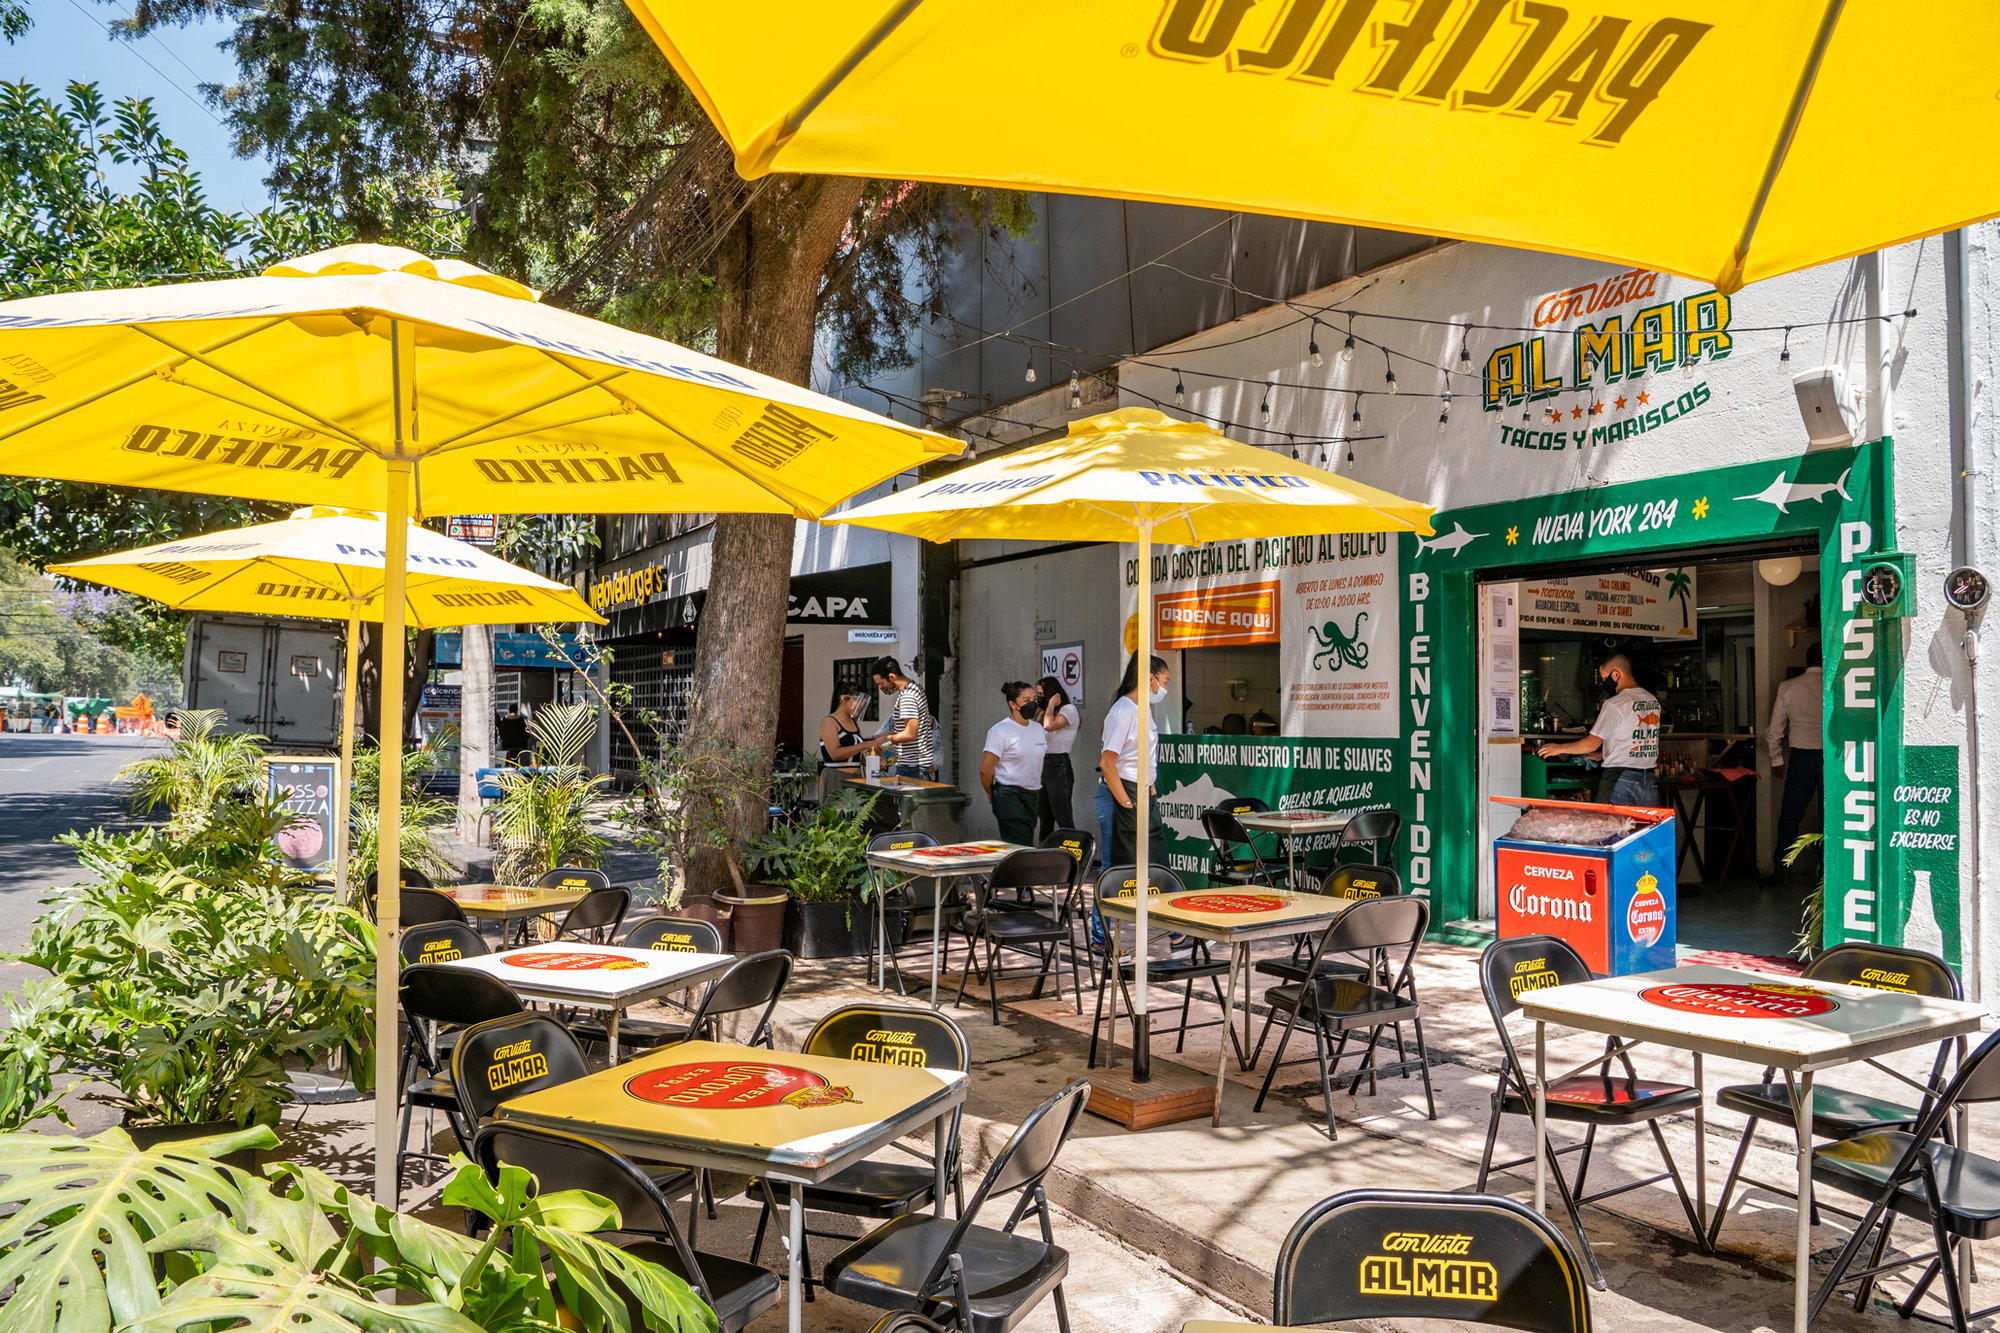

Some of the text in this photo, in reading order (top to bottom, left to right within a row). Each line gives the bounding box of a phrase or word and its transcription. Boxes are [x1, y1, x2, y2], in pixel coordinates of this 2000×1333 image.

[1482, 289, 1733, 412] AL MAR
[1501, 381, 1711, 450] TACOS Y MARISCOS
[1138, 471, 1310, 488] PACIFICO
[1532, 498, 1679, 545] NUEVA YORK 264
[1171, 542, 1223, 582] COSTEÑA
[1227, 541, 1250, 573] DEL
[1318, 534, 1335, 564] AL
[1320, 579, 1328, 591] DE
[1328, 576, 1347, 591] LUNES
[1347, 576, 1353, 588] A
[1353, 573, 1384, 588] DOMINGO
[1306, 598, 1313, 610] DE
[1331, 596, 1337, 607] A
[1162, 608, 1226, 625] ORDENE
[1572, 618, 1598, 626] GRACIAS
[1600, 620, 1612, 628] POR
[1622, 622, 1660, 631] PREFERENCIA
[854, 631, 897, 641] weloveburgers
[1043, 655, 1058, 674] NO
[1178, 745, 1194, 765] SIN
[1197, 746, 1236, 766] PROBAR
[1240, 747, 1289, 768] NUESTRO
[1293, 747, 1321, 770] FLAN
[1325, 748, 1340, 770] DE
[1344, 748, 1392, 773] SUAVES
[1279, 792, 1311, 811] CHELAS
[1312, 789, 1326, 806] DE
[1326, 782, 1373, 806] AQUELLAS
[1894, 785, 1952, 804] CONOCER
[1904, 808, 1941, 827] ES NO
[1843, 741, 1875, 944] USTE
[1889, 831, 1957, 850] EXCEDERSE
[1524, 865, 1575, 881] CERVEZA
[1508, 883, 1593, 923] Corona
[1635, 899, 1659, 907] CERVEZA
[1630, 908, 1664, 926] Corona
[1660, 986, 1811, 1014] Corona
[1709, 986, 1809, 1005] CERVEZA
[1671, 998, 1748, 1014] EXTRA
[652, 1067, 713, 1089] EXTRA
[664, 1065, 783, 1104] Corona
